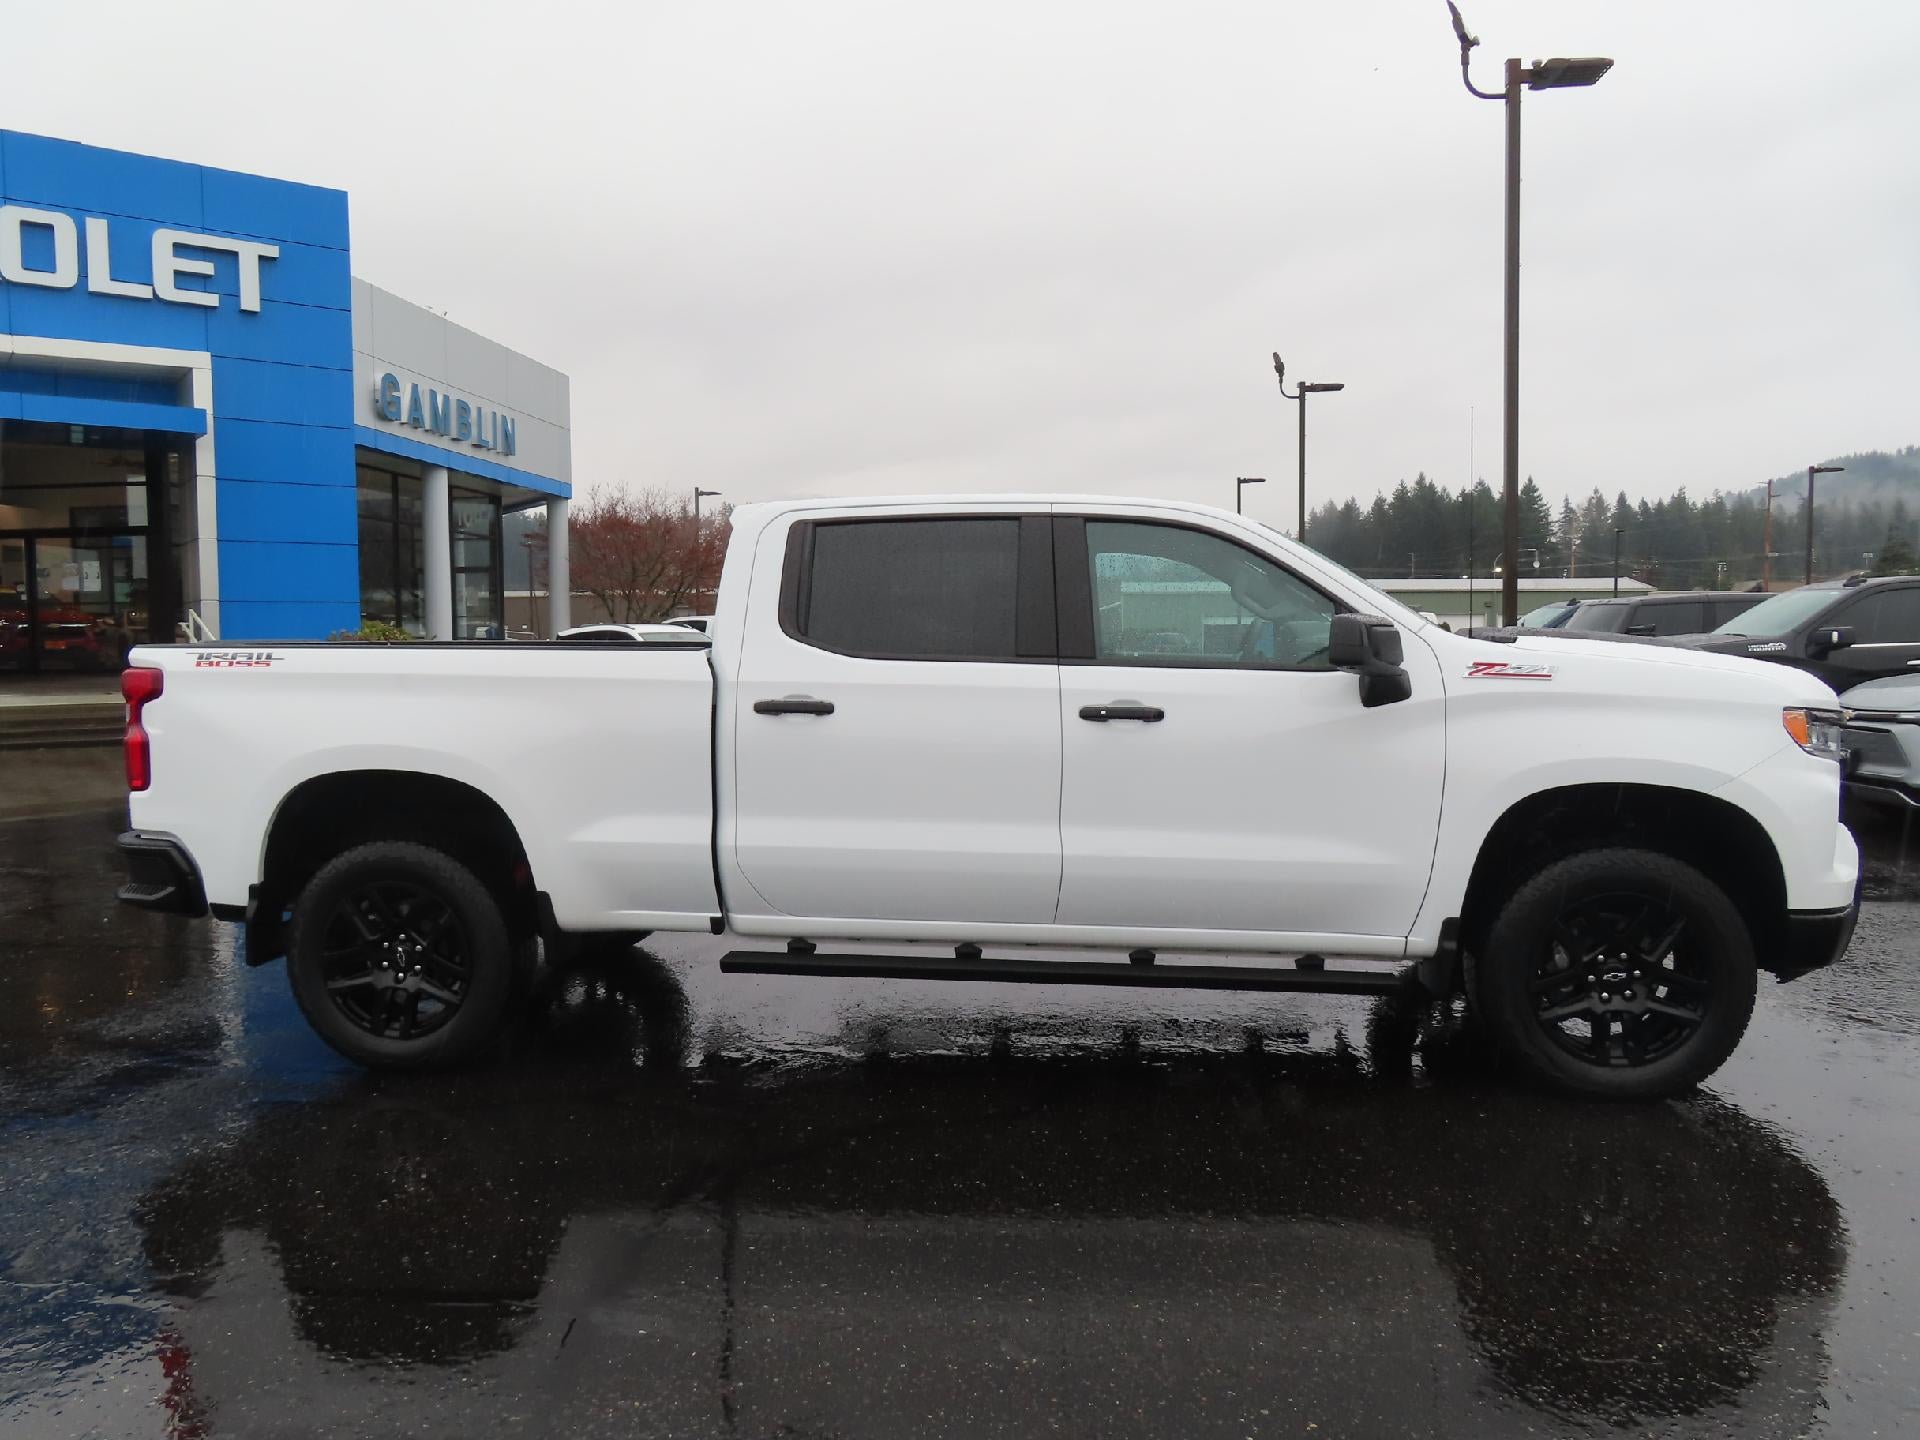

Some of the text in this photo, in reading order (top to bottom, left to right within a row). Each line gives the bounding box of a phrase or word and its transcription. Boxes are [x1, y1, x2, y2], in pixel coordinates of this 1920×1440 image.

[0, 205, 280, 313] OLET
[376, 372, 516, 457] GAMBLIN
[186, 652, 284, 660] TRAIL
